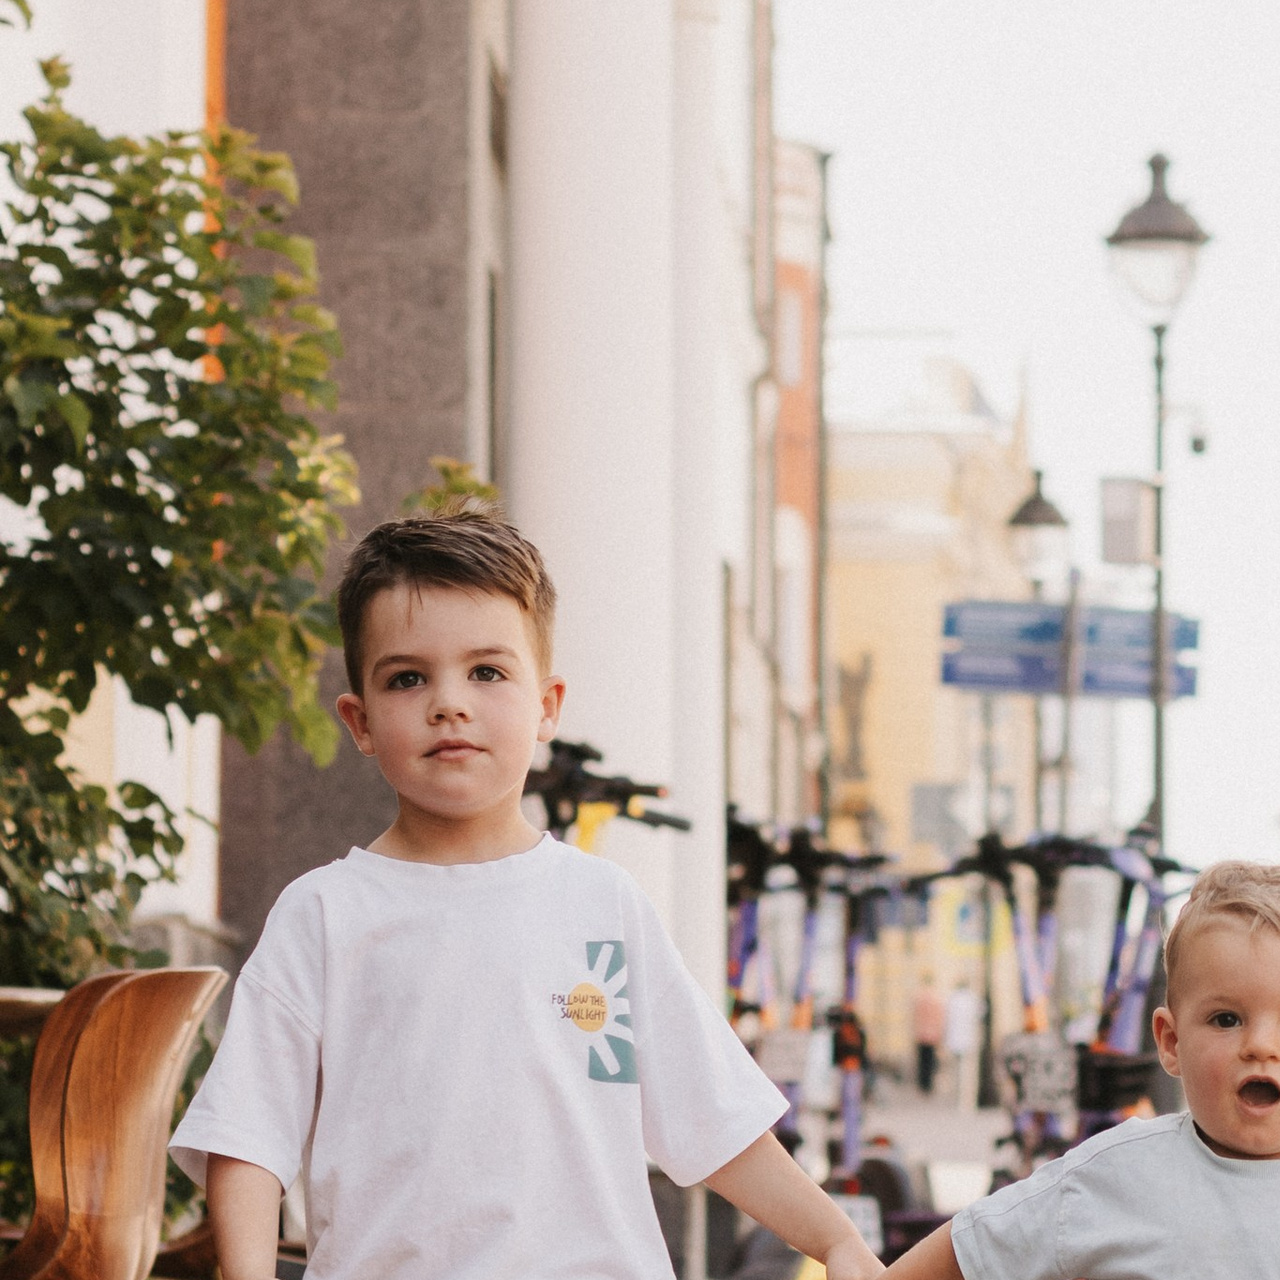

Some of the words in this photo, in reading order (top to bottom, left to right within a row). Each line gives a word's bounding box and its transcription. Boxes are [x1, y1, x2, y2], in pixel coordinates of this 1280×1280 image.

[552, 993, 588, 1006] FOLLOW
[590, 995, 606, 1007] THE
[560, 1007, 606, 1021] SUNLIGHT
